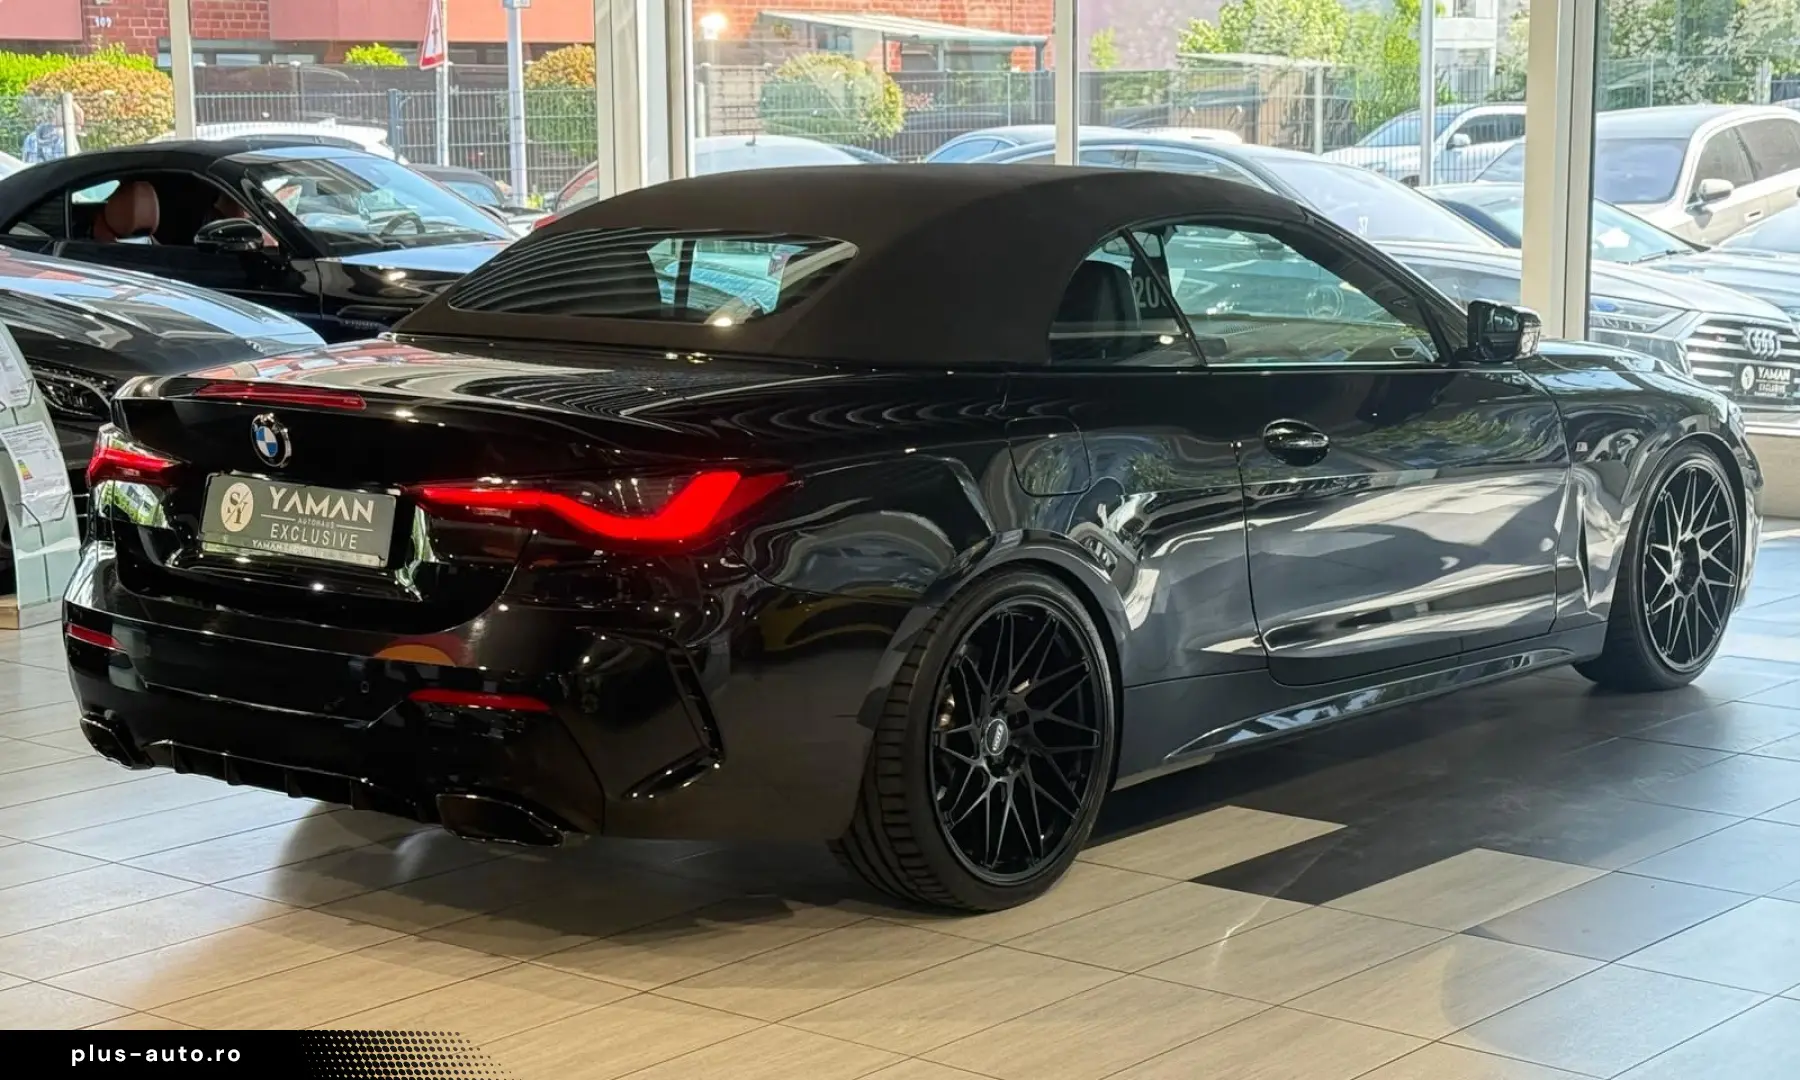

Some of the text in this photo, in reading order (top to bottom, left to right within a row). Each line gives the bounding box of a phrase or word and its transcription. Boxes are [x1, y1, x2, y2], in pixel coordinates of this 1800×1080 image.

[1758, 366, 1791, 380] YAMAN
[269, 486, 374, 523] YAMAN
[297, 517, 335, 529] AUTOHAUS
[270, 523, 359, 550] EXCLUSIVE
